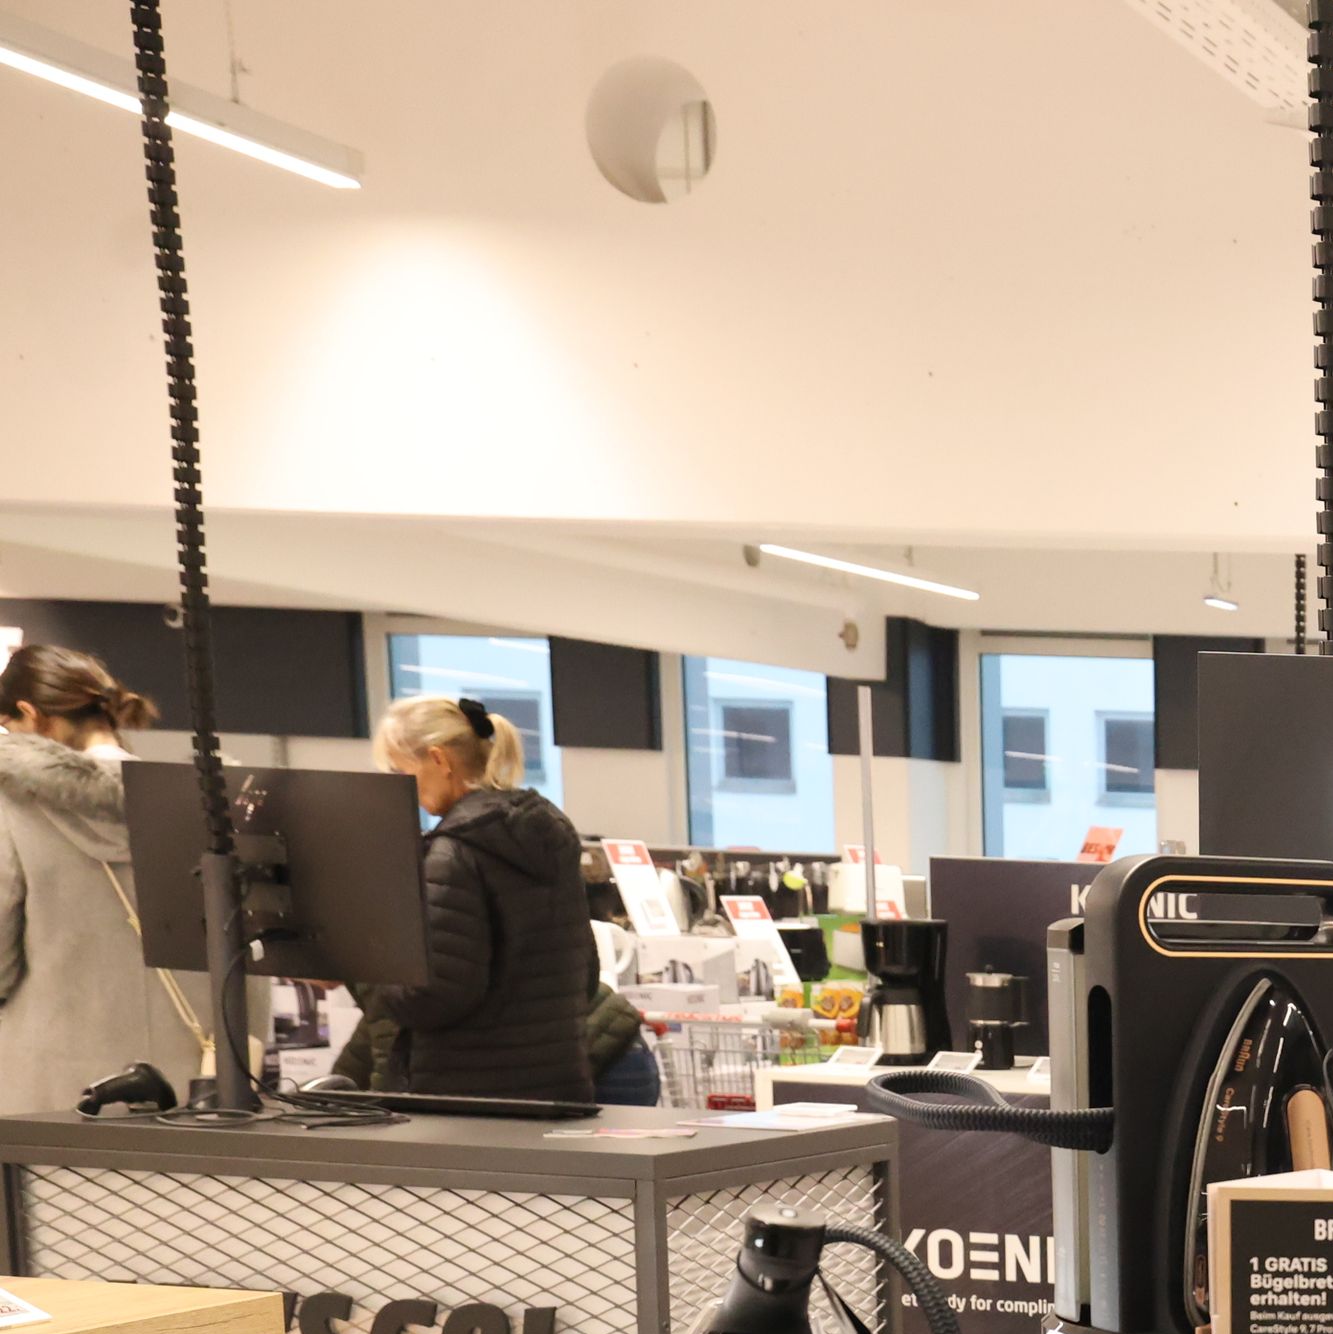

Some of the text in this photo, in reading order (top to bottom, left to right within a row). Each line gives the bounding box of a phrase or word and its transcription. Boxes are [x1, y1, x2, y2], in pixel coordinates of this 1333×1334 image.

[1249, 1256, 1328, 1272] 1 GRATIS
[970, 1294, 992, 1311] for
[1249, 1291, 1328, 1306] erhalten!
[1277, 1311, 1300, 1320] Kauf
[1250, 1324, 1298, 1334] CareStyle
[1317, 1324, 1333, 1334] Pro
